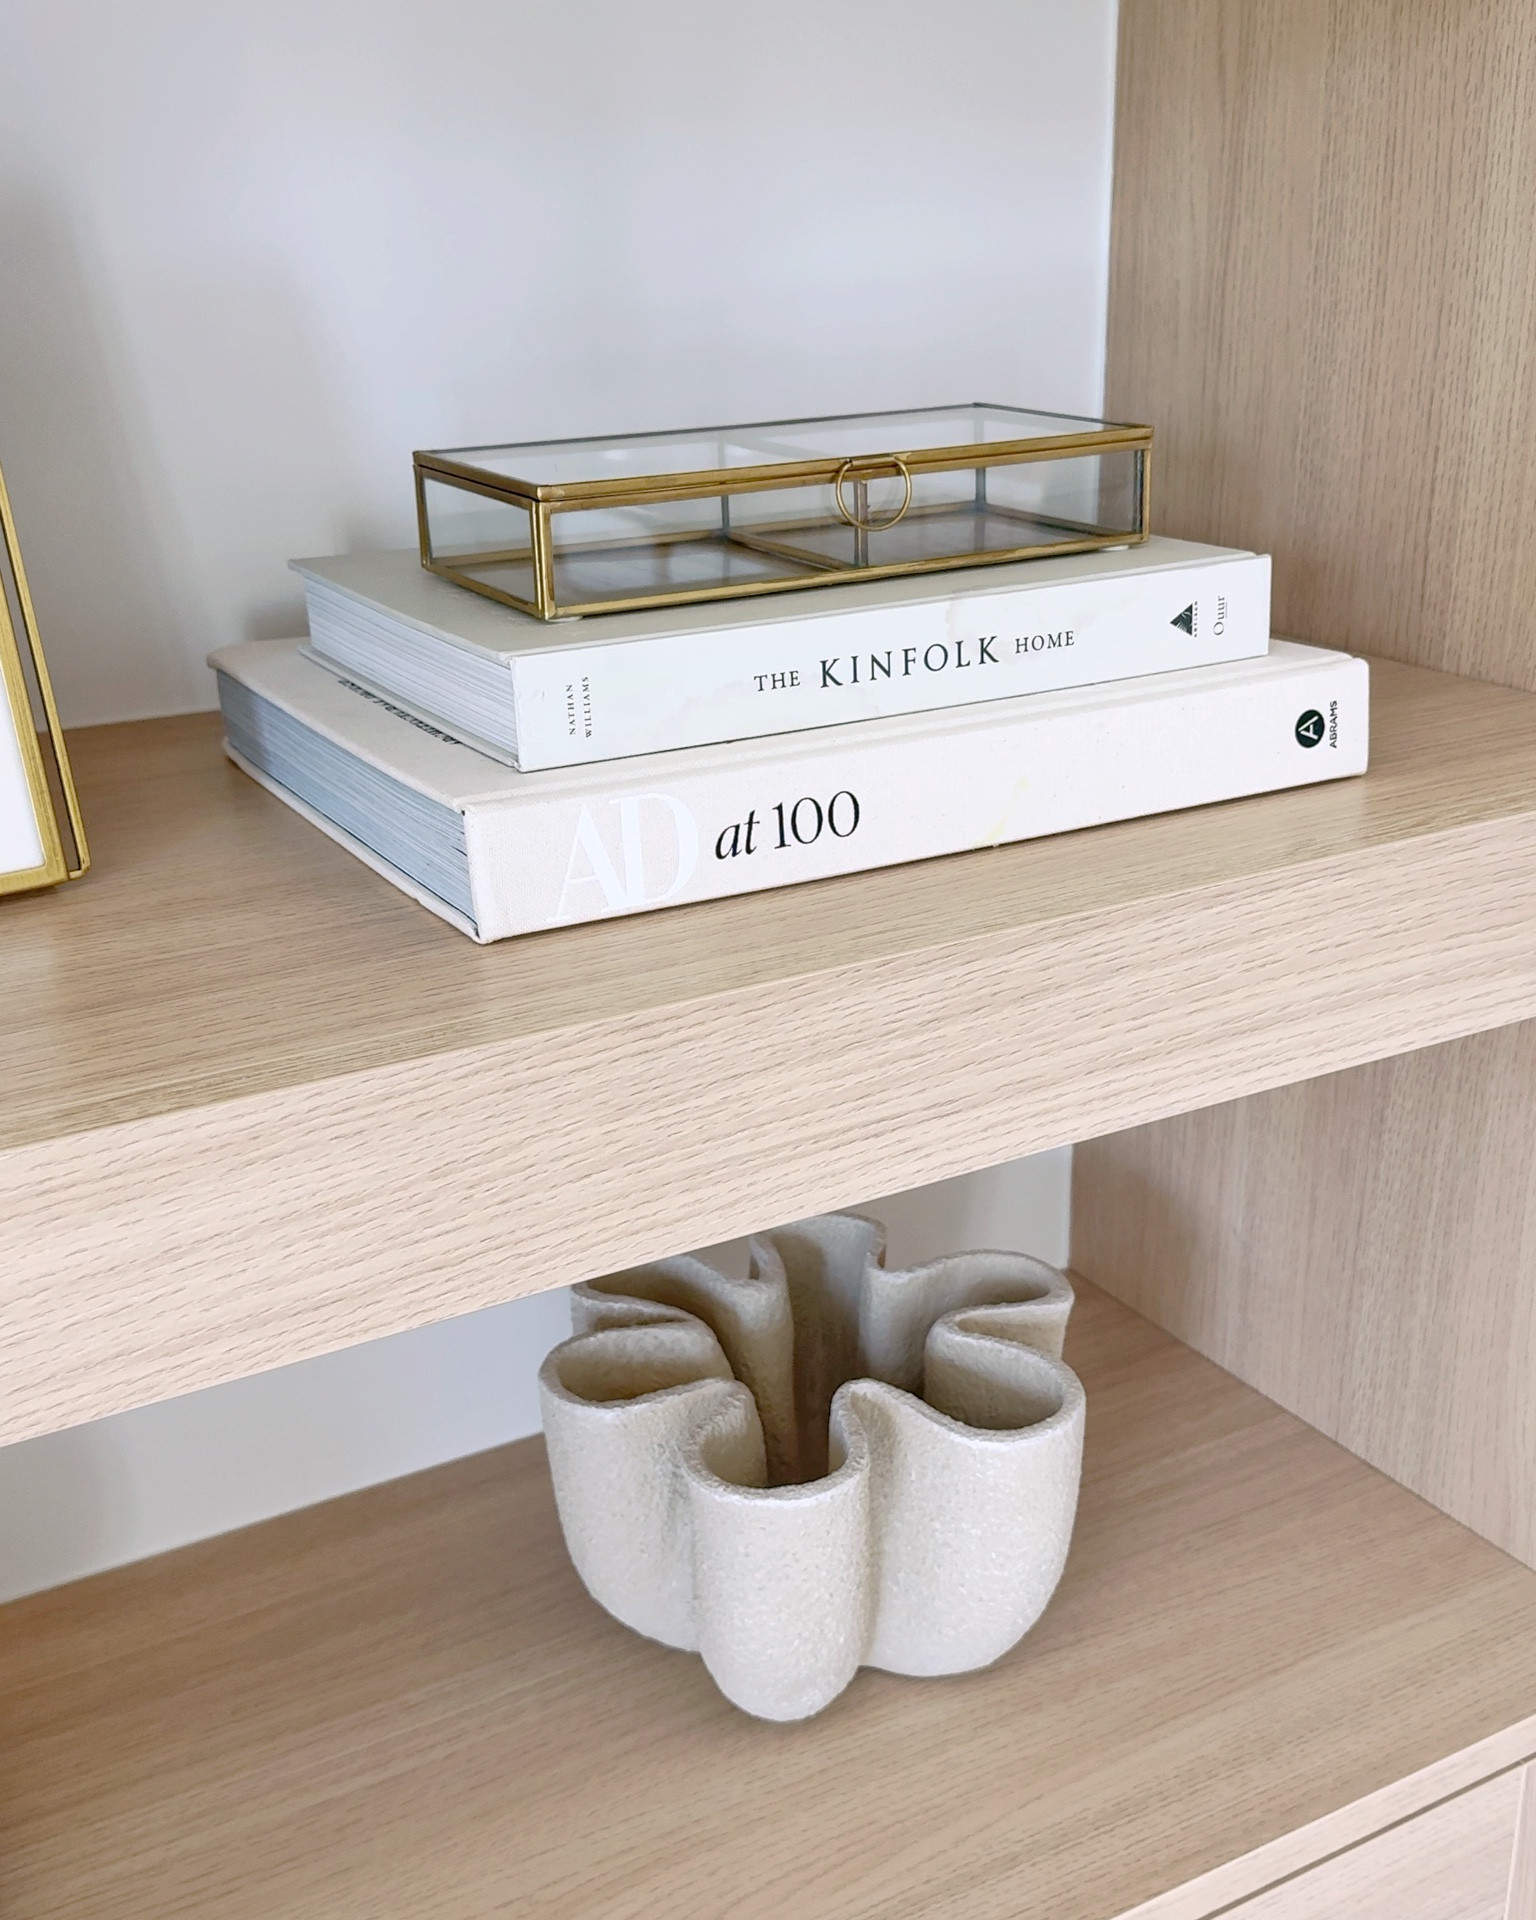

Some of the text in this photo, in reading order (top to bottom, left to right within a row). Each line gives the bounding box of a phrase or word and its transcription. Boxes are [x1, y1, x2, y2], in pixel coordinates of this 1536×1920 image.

[1213, 595, 1226, 635] Ouur
[753, 630, 1075, 692] THE KINFOLK HOME
[565, 684, 576, 736] NATHAN
[581, 676, 592, 738] WILLIAMS
[1329, 699, 1338, 749] ABRAMS
[546, 790, 861, 923] AD at 100
